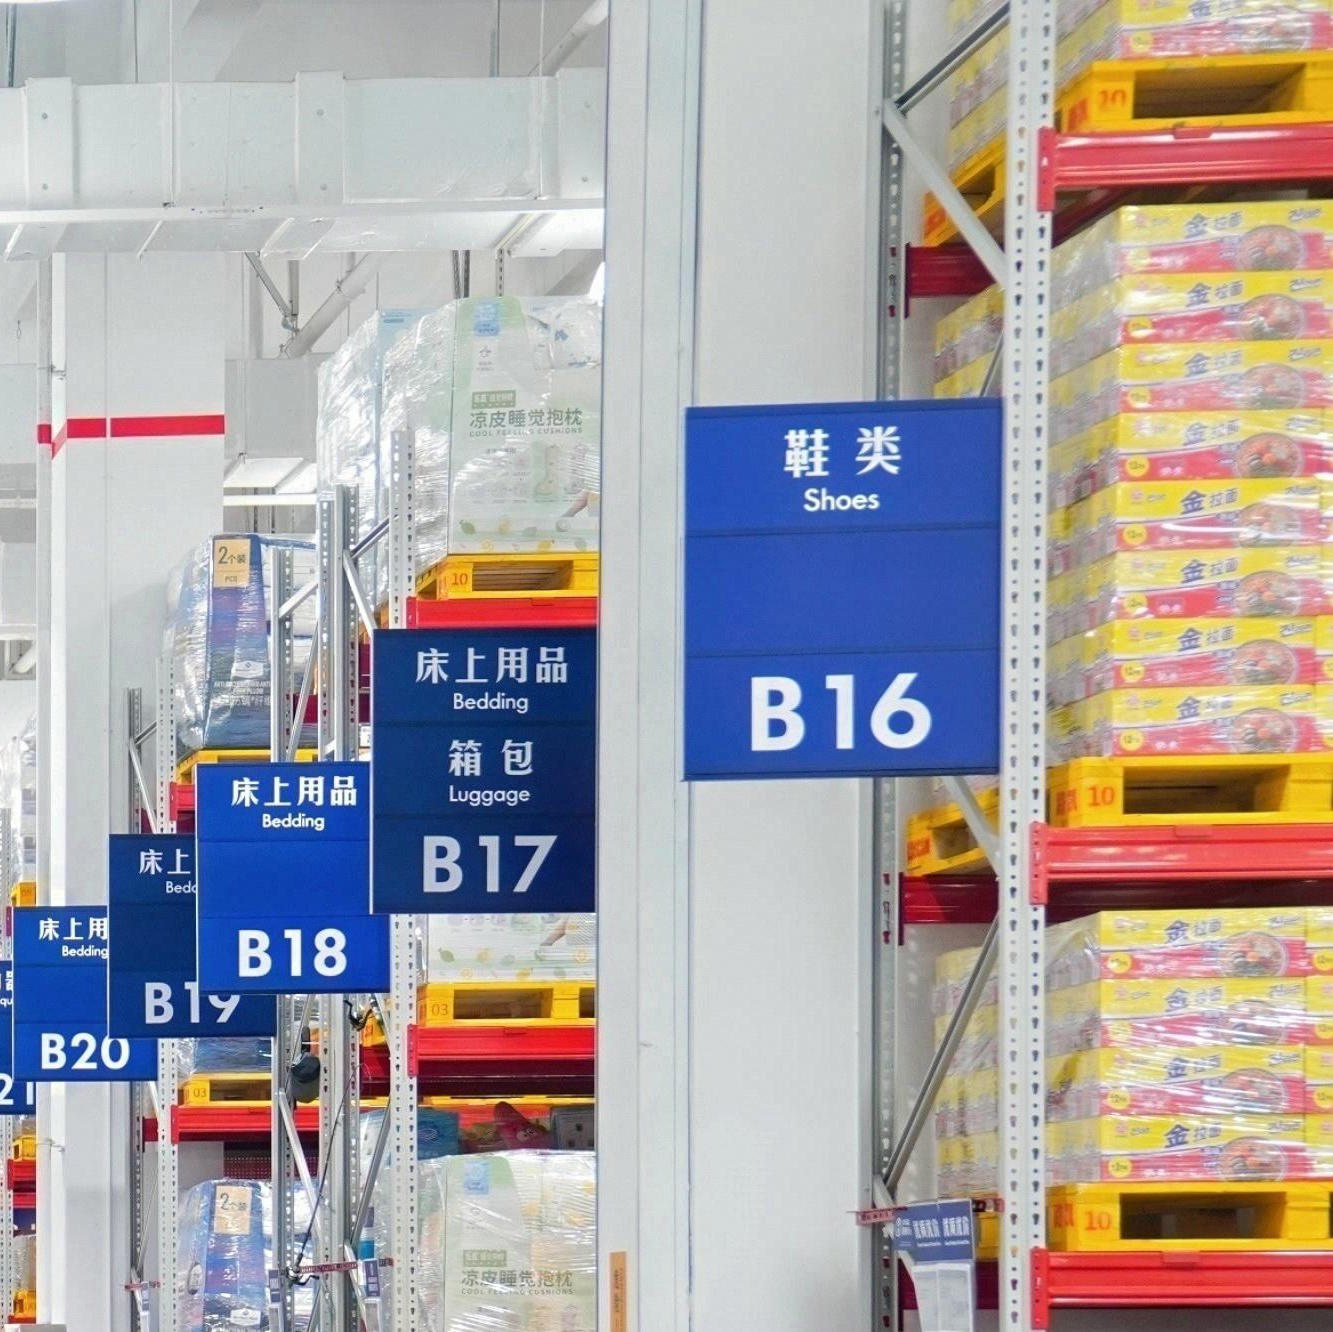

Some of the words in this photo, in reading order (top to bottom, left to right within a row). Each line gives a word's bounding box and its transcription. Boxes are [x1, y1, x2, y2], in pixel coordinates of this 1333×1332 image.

[783, 426, 902, 479] 鞋类
[803, 487, 880, 512] Shoes
[451, 572, 468, 586] 10
[415, 646, 568, 684] 床上用品
[453, 691, 529, 714] Bedding
[751, 672, 932, 752] B16
[448, 739, 533, 777] 箱包
[231, 775, 357, 808] 床上用品
[449, 785, 531, 805] Luggage
[1088, 786, 1115, 806] 10
[262, 813, 325, 831] Bedding
[422, 835, 558, 893] B17
[238, 928, 347, 978] B18
[145, 983, 241, 1025] B19
[431, 1003, 449, 1016] 03
[40, 1032, 131, 1070] B20
[193, 1087, 206, 1098] 03
[1085, 1211, 1111, 1231] 10
